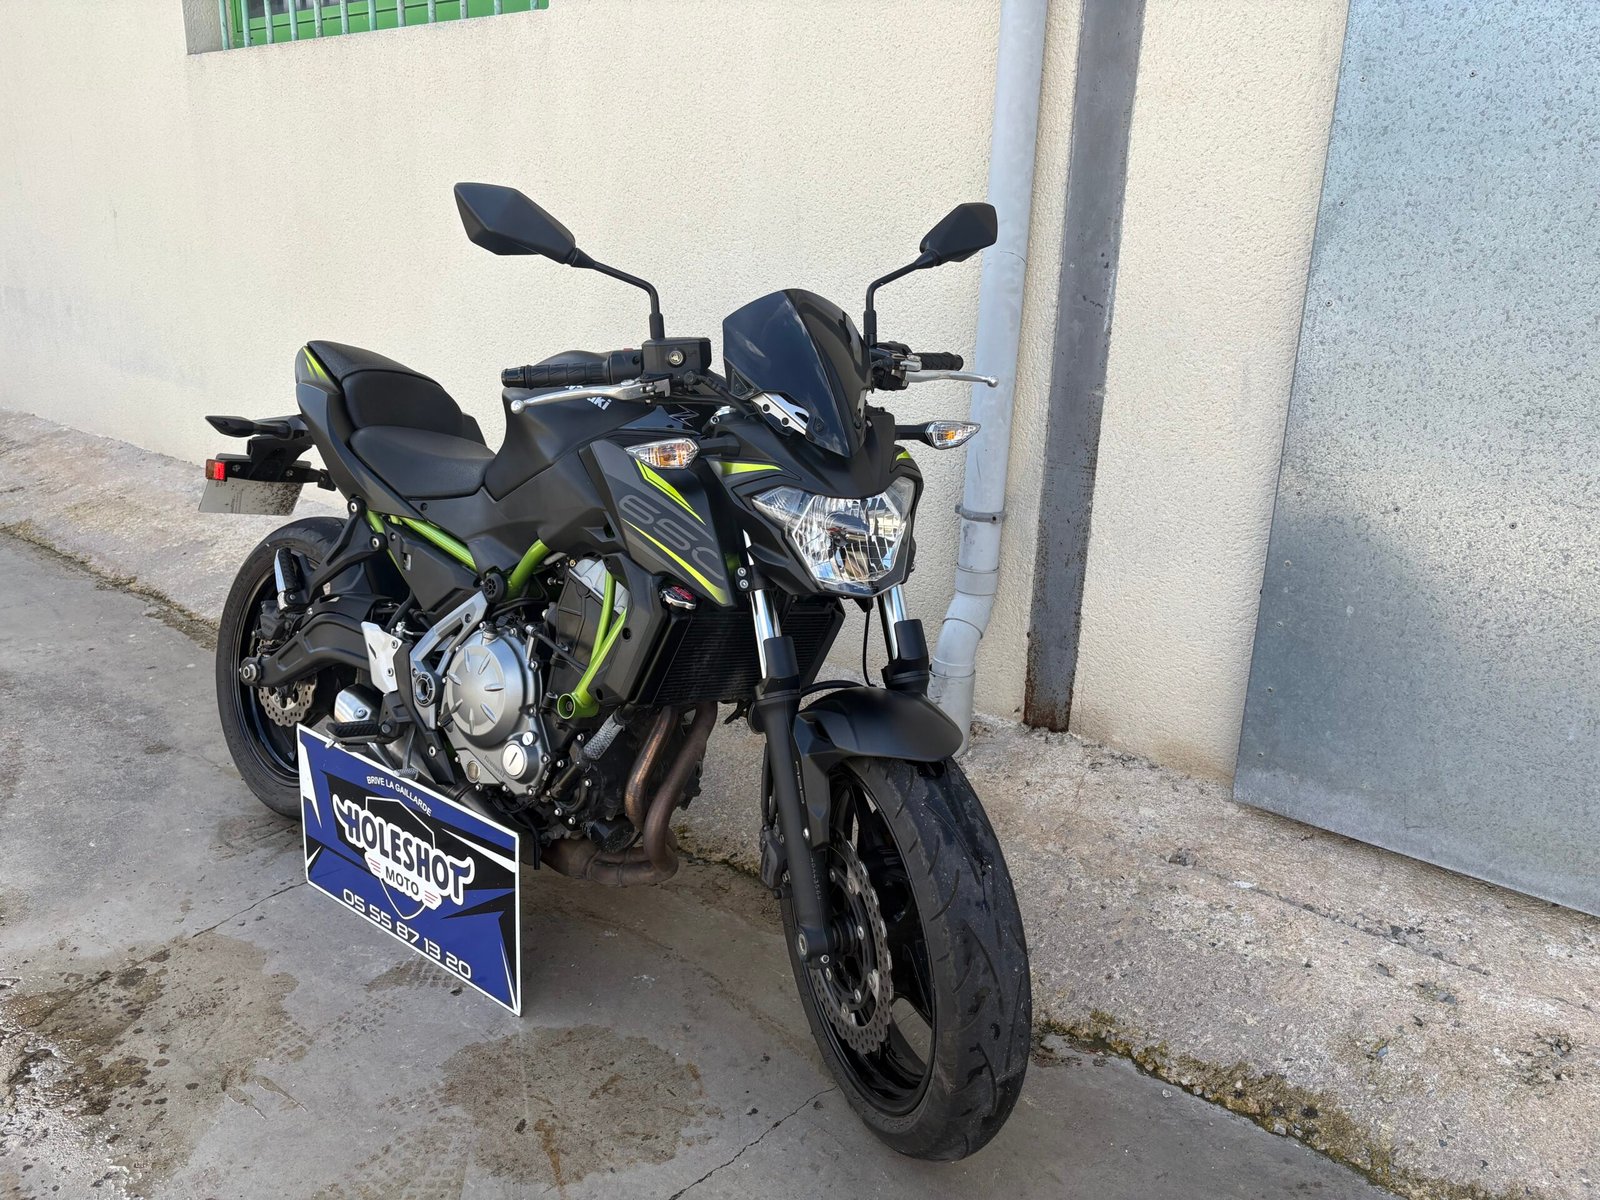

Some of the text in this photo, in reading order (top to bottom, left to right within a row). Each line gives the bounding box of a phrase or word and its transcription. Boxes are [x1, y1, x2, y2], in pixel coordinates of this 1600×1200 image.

[366, 776, 432, 817] BRIVE LA GAILLARDE
[334, 795, 473, 903] HOLESHOT
[385, 866, 419, 896] MOTO
[343, 888, 472, 979] 05 55 87 13 20
